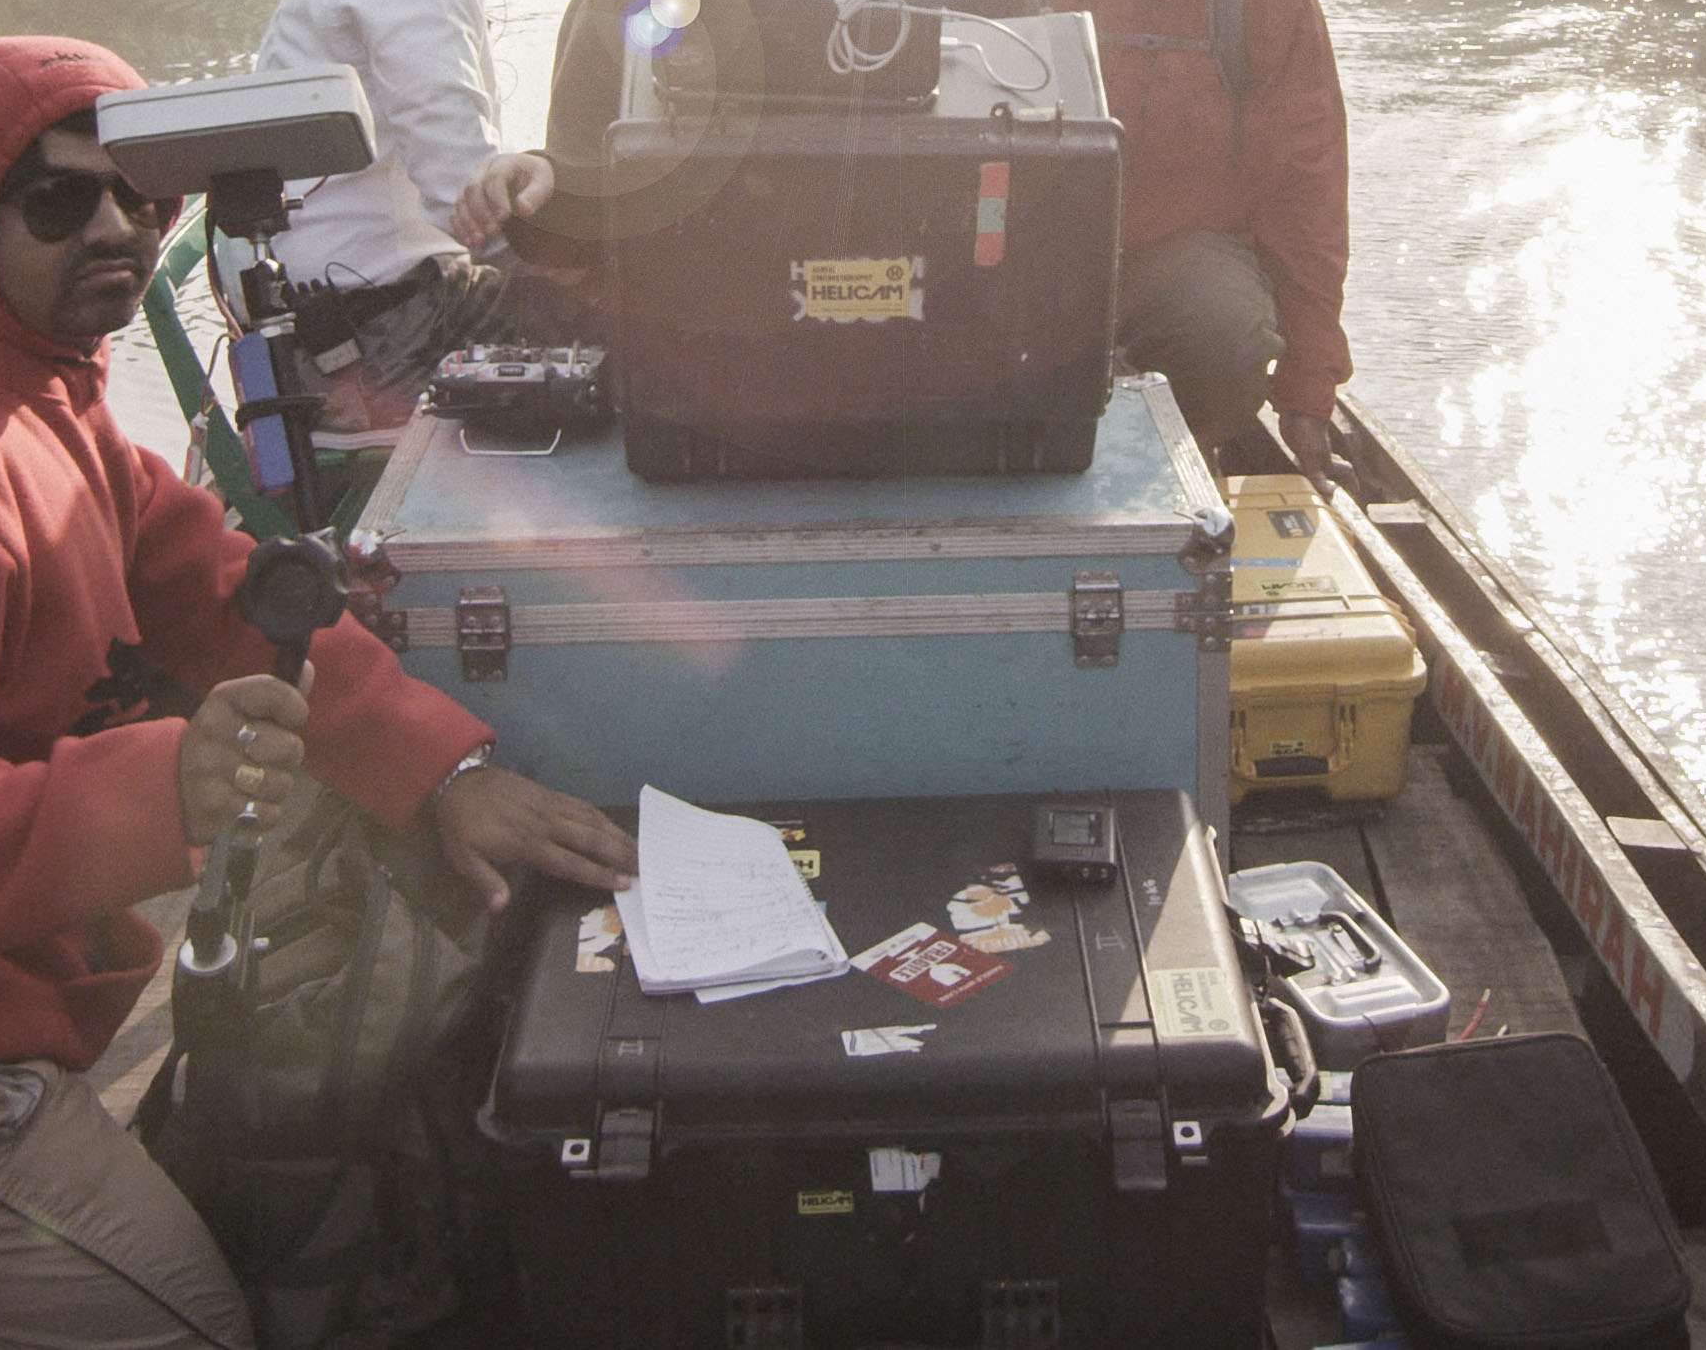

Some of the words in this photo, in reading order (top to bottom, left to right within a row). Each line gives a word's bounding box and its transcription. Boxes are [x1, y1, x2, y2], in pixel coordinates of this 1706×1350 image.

[811, 285, 903, 301] HELICAM
[895, 941, 954, 980] FRAGILE
[1170, 972, 1204, 1034] HELICAM
